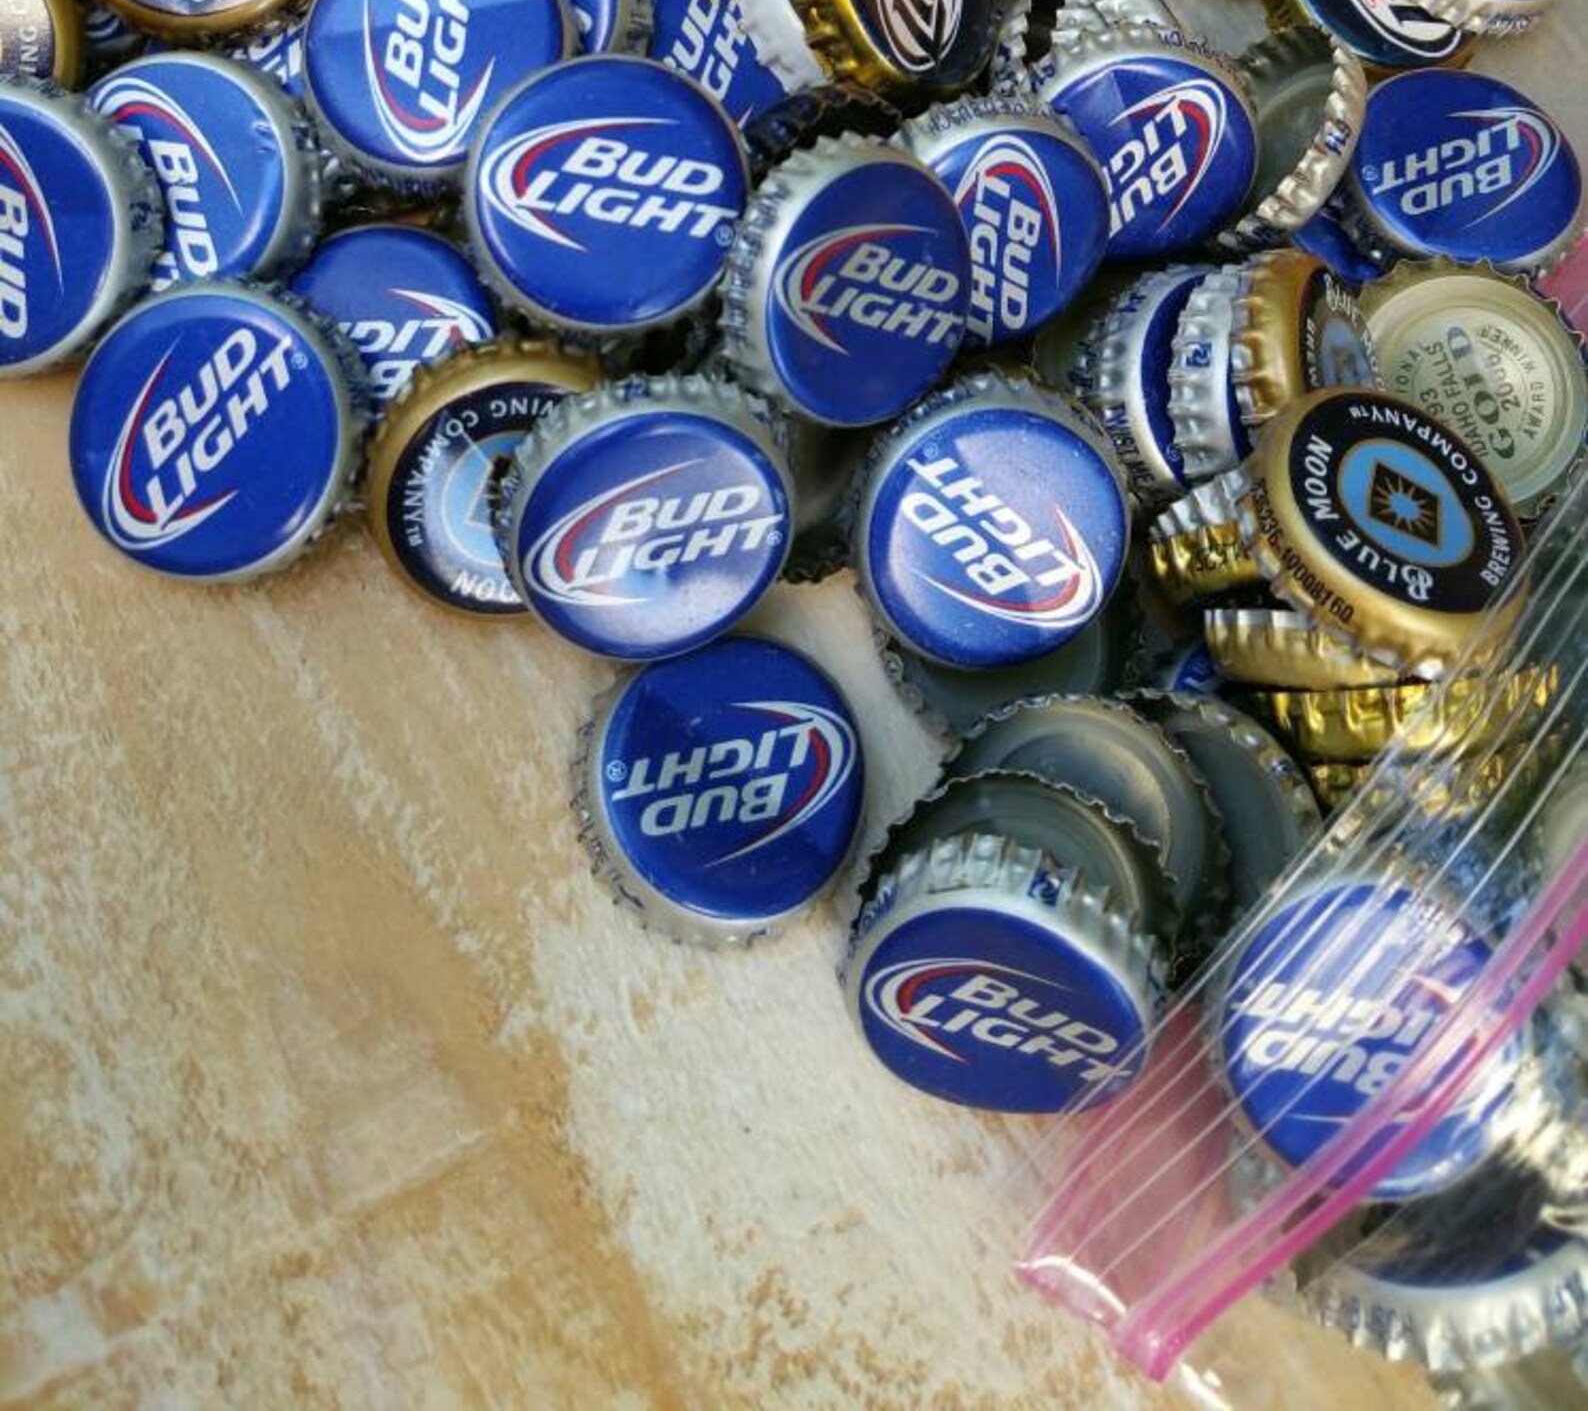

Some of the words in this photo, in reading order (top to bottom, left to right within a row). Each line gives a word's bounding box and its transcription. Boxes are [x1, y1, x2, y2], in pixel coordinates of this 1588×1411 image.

[561, 136, 724, 195] BUD
[1102, 98, 1188, 194] LIG
[1371, 112, 1525, 194] LIGHT
[1401, 156, 1513, 216] BUD
[148, 140, 218, 276] BUD
[516, 171, 739, 242] LIGHT
[0, 184, 28, 339] BUD
[839, 242, 960, 303] BUD
[1000, 199, 1042, 330] BUD
[339, 315, 463, 356] LIG
[799, 274, 968, 345] LIGHT
[143, 327, 257, 471] BUD
[1425, 340, 1460, 400] FALLS
[144, 334, 293, 530] LIGHT
[402, 410, 480, 521] COMPANY
[1367, 405, 1480, 485] COMPANY
[599, 485, 764, 545] BUD
[1304, 435, 1334, 523] MOON
[570, 512, 785, 589] LIGHT
[901, 492, 1031, 596] BUD
[906, 457, 1084, 587] LIGHT
[1478, 493, 1513, 588] BREWING
[1336, 531, 1435, 603] BLUE
[611, 718, 817, 802] LIGHT
[639, 773, 788, 837] BUD
[900, 994, 1133, 1084] LIGHT
[948, 973, 1120, 1055] BUD
[1245, 1028, 1411, 1097] BUD
